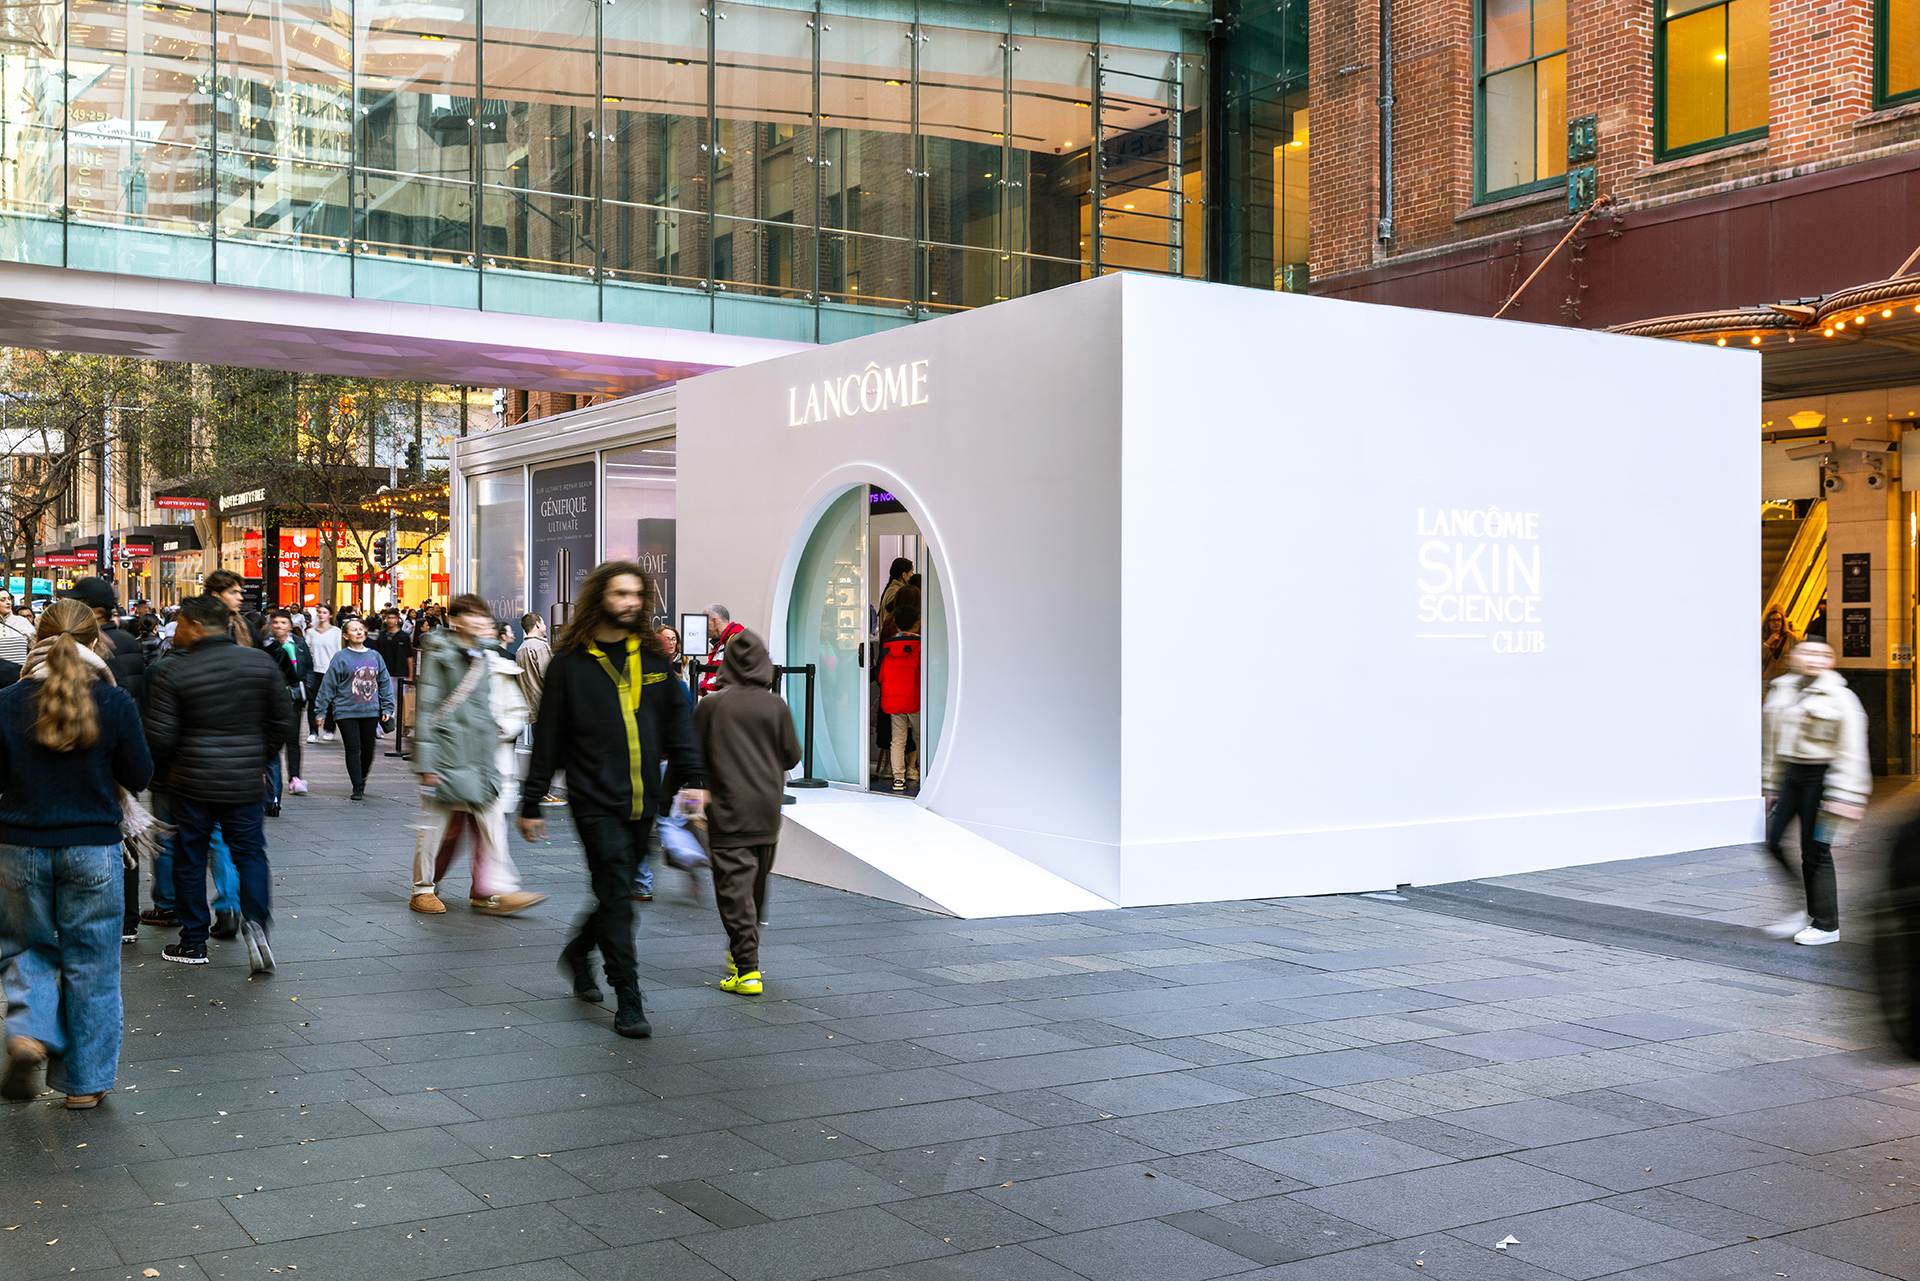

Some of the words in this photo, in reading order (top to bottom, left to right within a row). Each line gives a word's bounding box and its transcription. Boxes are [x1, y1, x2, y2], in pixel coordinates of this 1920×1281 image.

[97, 124, 155, 144] Simpon
[789, 359, 929, 427] LANCÔME
[540, 496, 587, 518] GÉNIFIQUE
[548, 518, 579, 533] ULTIMATE
[1417, 505, 1540, 540] LANCÔME
[279, 550, 299, 559] Earn
[637, 552, 667, 574] CÔME
[1416, 540, 1540, 594] SKIN
[487, 595, 521, 620] NCÔME
[1418, 594, 1542, 623] SCIENCE
[1492, 630, 1545, 654] CLUB
